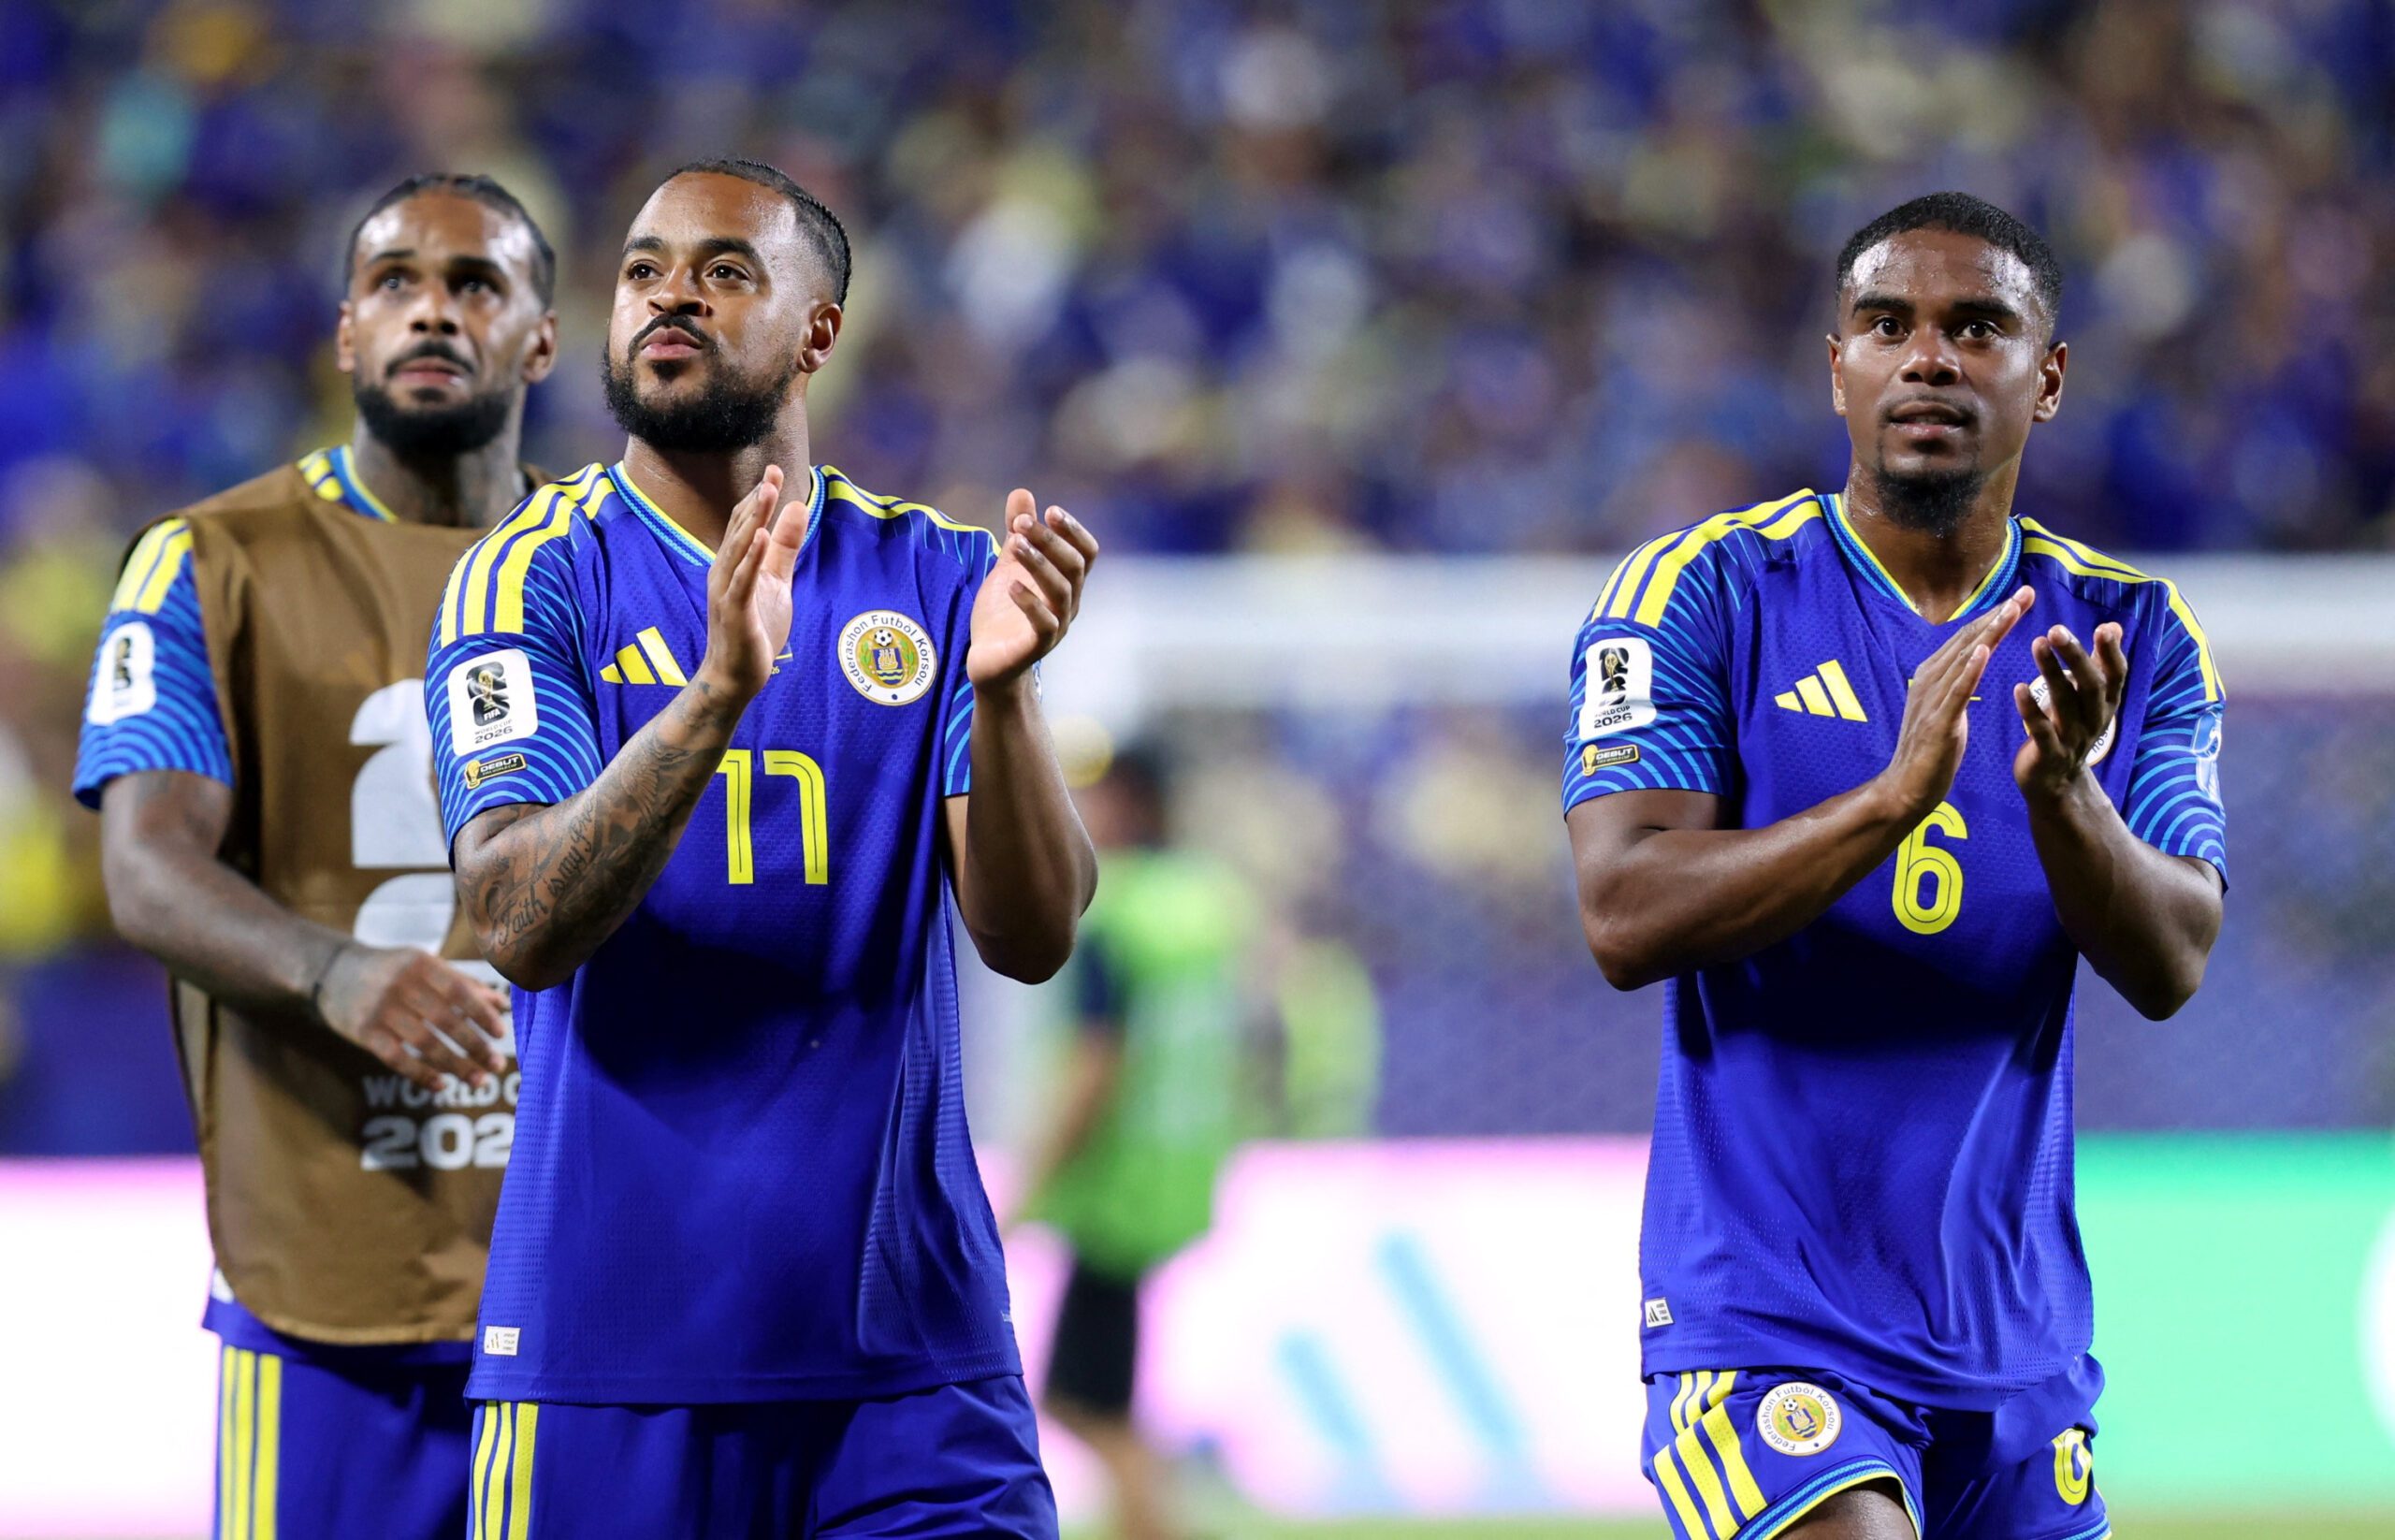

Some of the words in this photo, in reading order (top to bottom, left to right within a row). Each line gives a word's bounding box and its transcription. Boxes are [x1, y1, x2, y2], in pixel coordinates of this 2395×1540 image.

[483, 708, 501, 721] FIFA
[1593, 712, 1633, 729] 2026
[474, 725, 514, 744] 2026
[1595, 748, 1633, 761] DEBUT
[480, 756, 519, 773] DEBUT
[716, 748, 829, 885] 17
[1892, 800, 1968, 936] 6
[361, 1112, 515, 1170] 202
